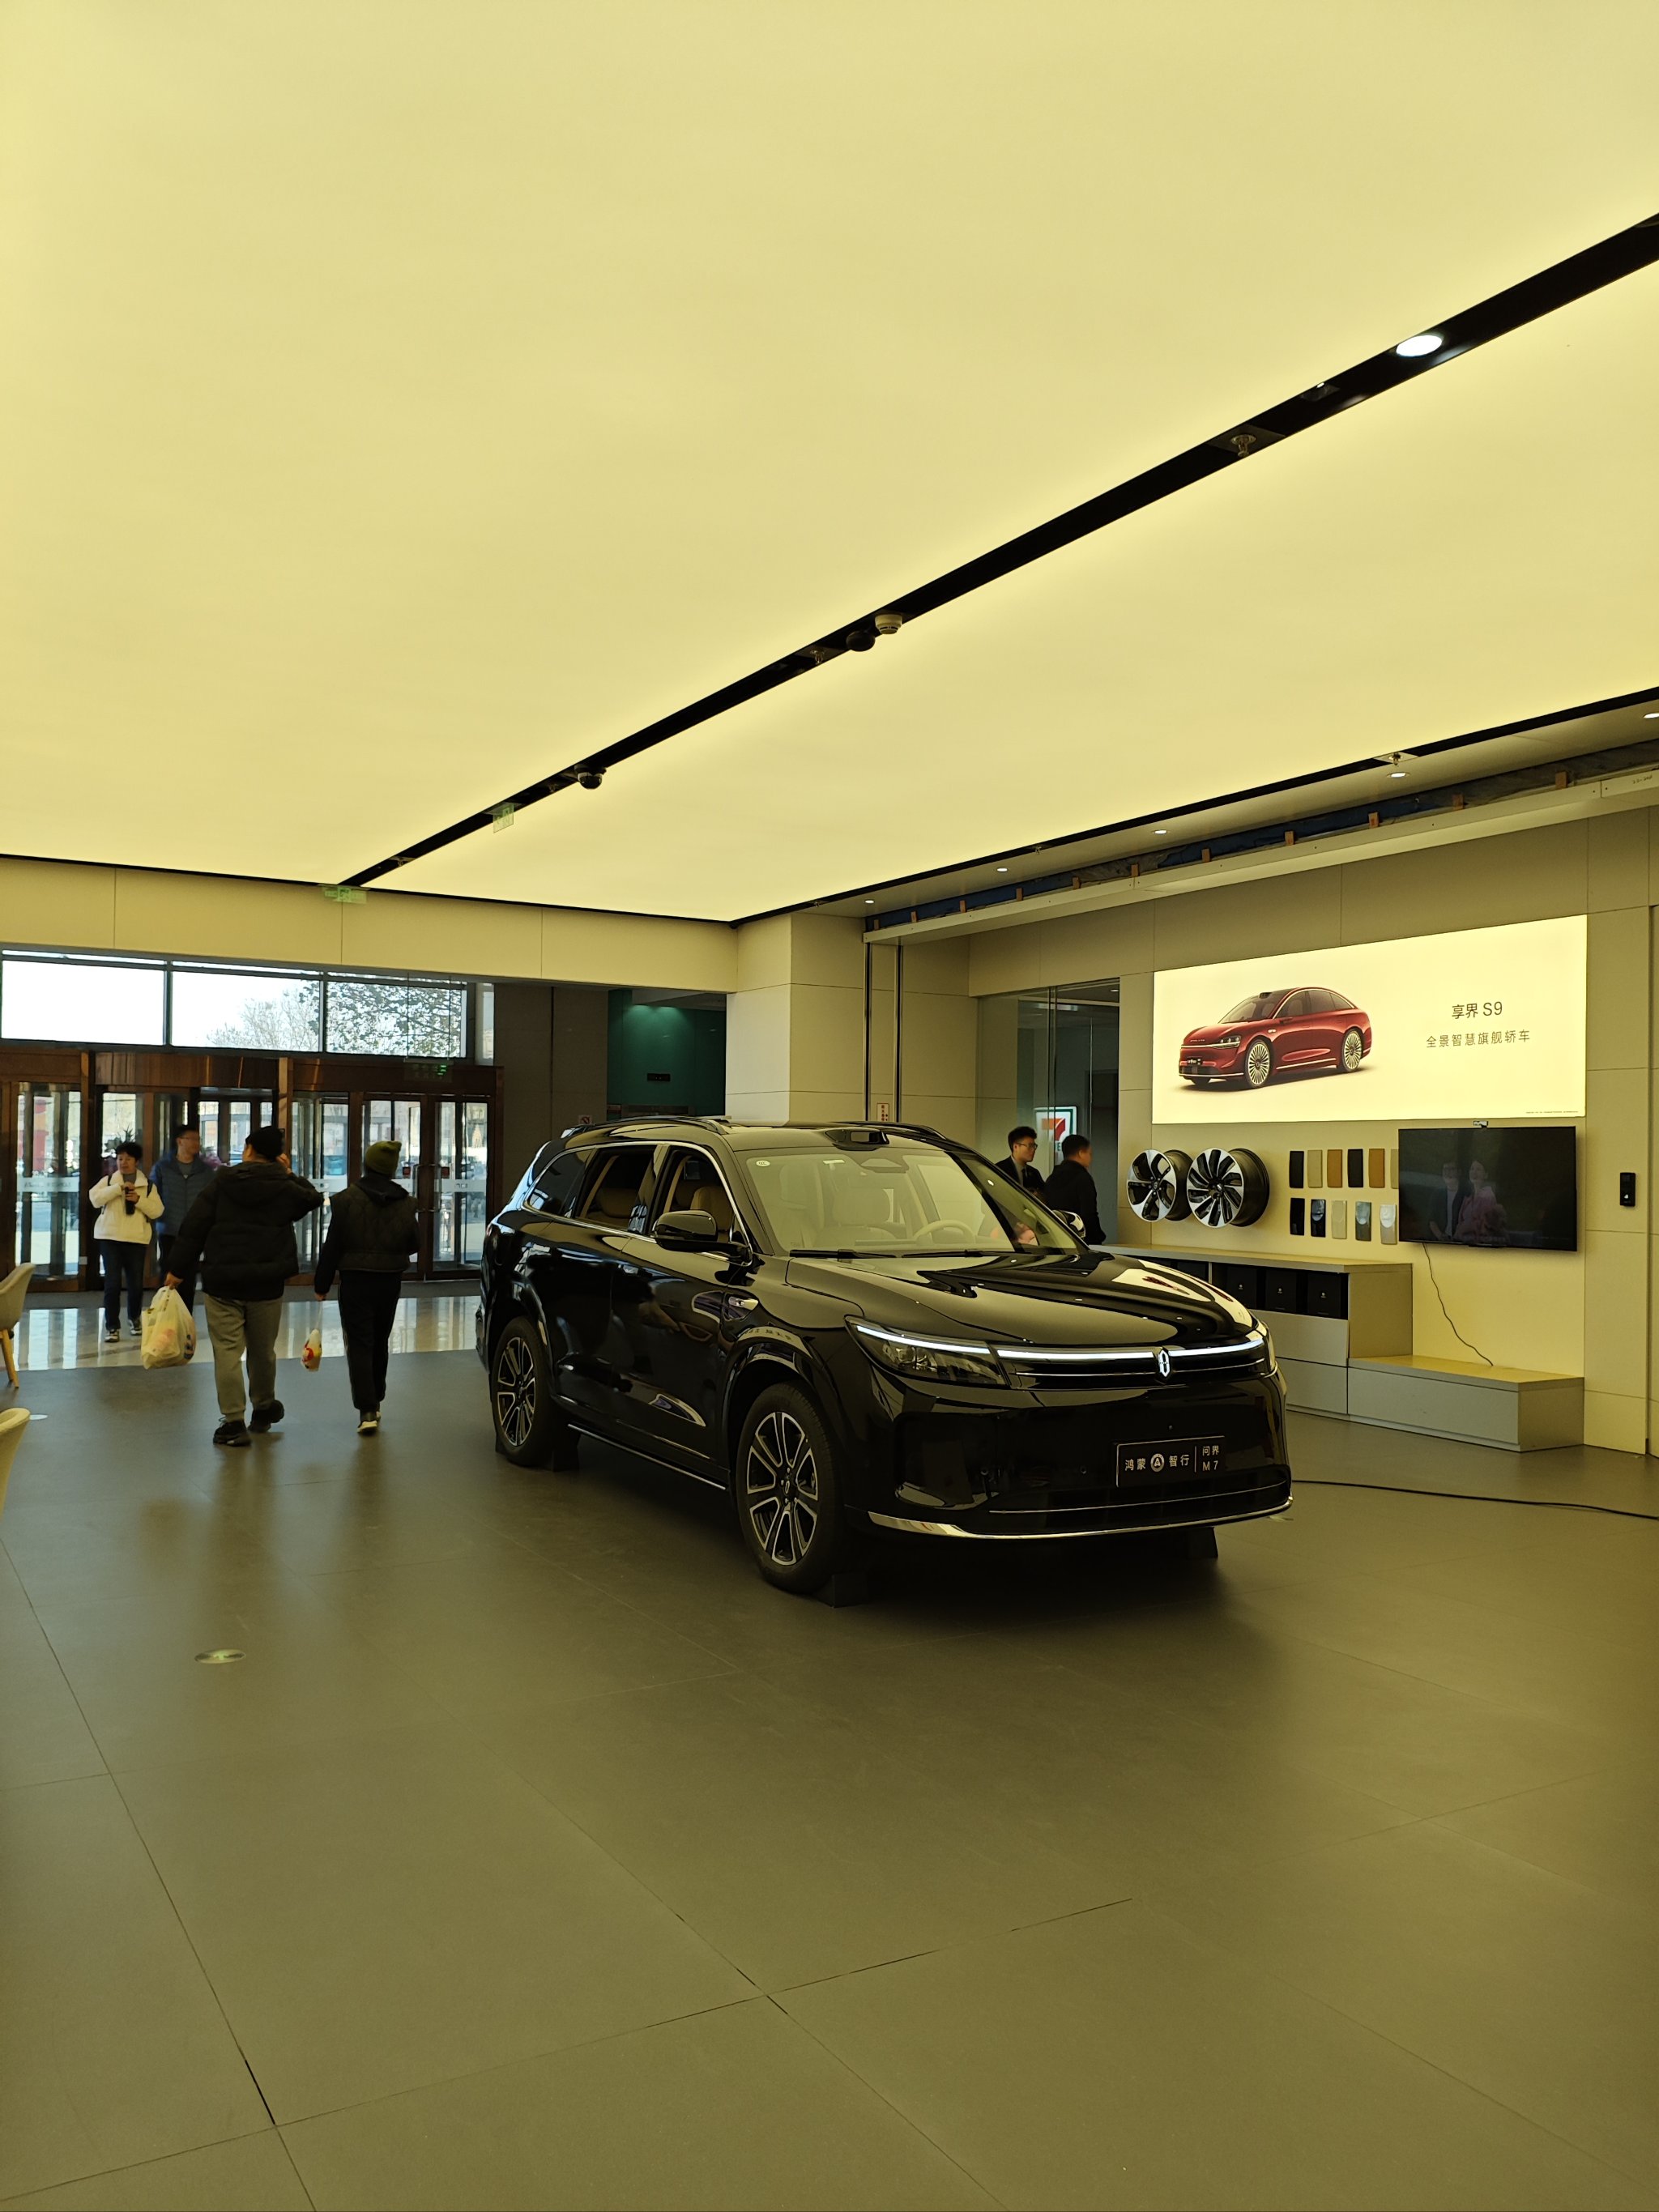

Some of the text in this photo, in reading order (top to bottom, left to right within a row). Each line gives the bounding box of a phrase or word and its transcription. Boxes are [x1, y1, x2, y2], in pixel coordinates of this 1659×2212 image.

[1452, 1001, 1503, 1020] 享界 S9
[1426, 1029, 1530, 1048] 全景智慧旗舰轿车
[1202, 1445, 1220, 1456] 问界
[1124, 1454, 1190, 1472] 鸿蒙 智行
